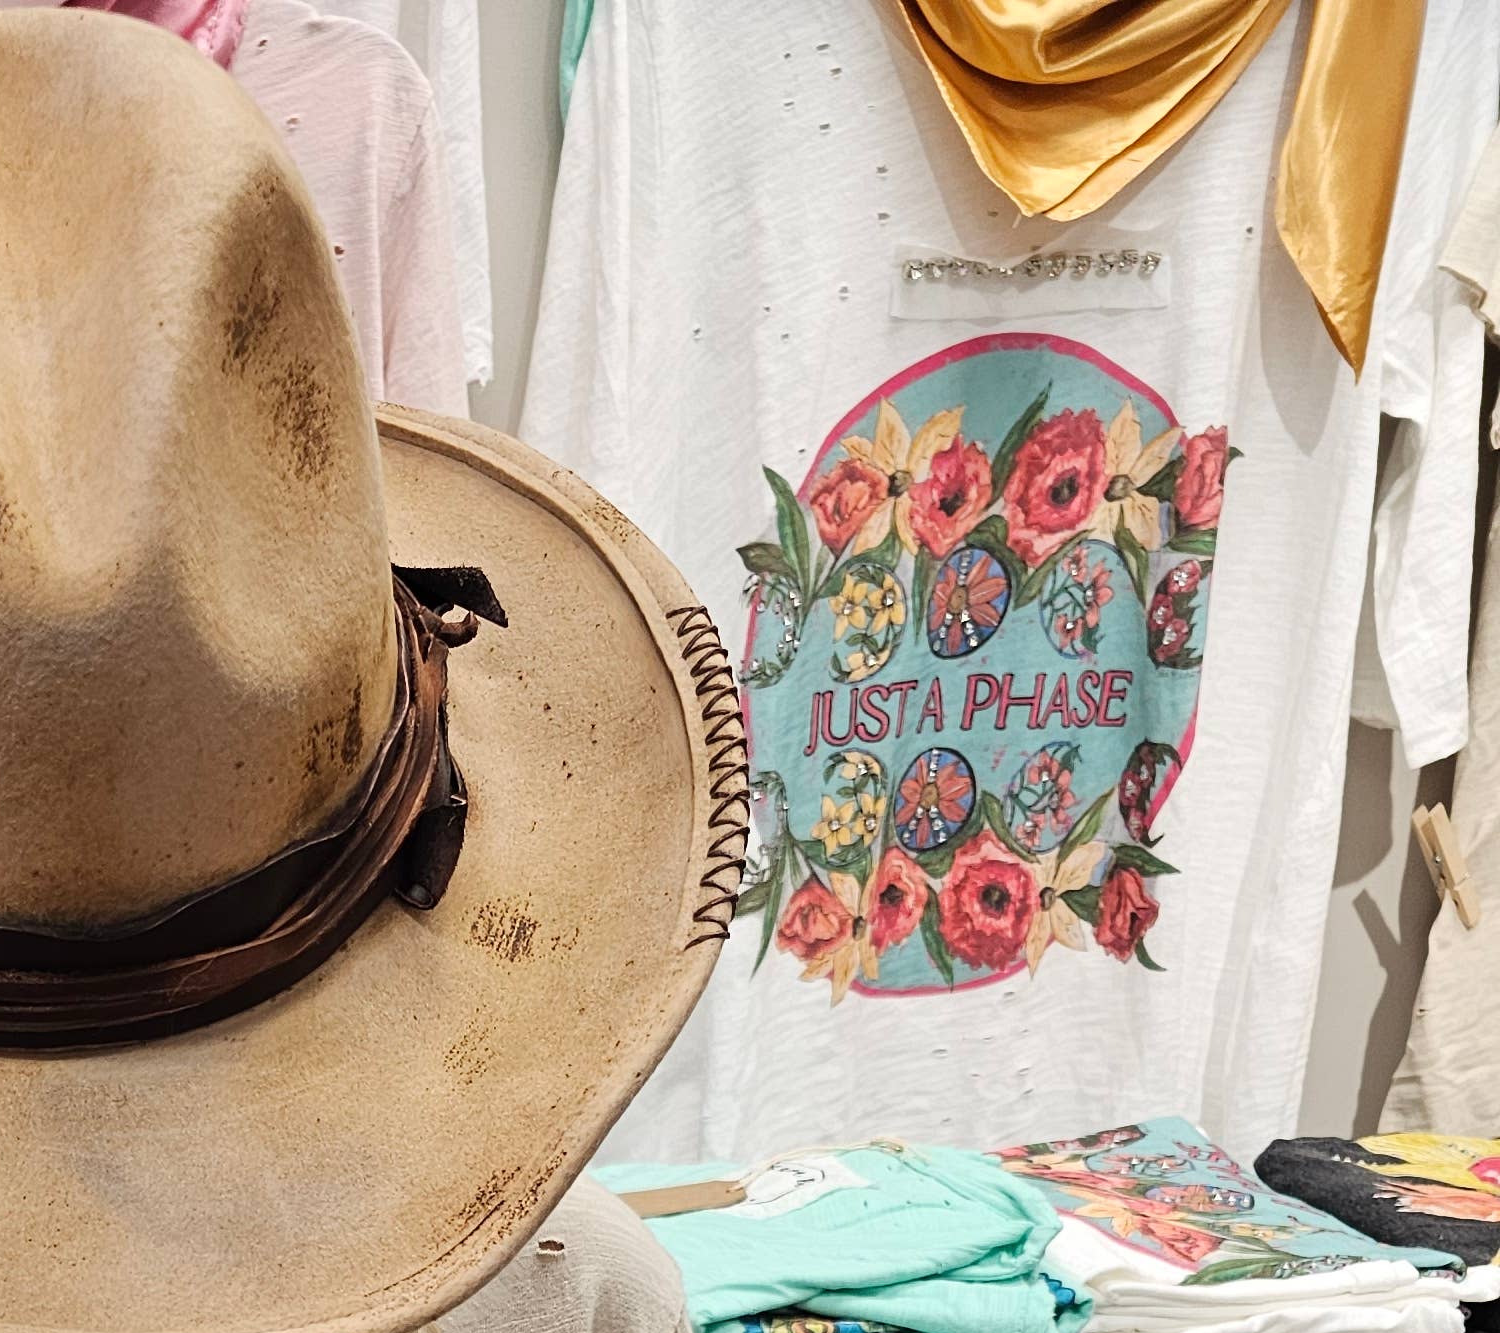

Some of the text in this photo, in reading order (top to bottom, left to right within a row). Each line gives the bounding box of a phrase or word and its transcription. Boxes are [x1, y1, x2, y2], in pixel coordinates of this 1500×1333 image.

[803, 669, 1134, 757] JUST A PHASE
